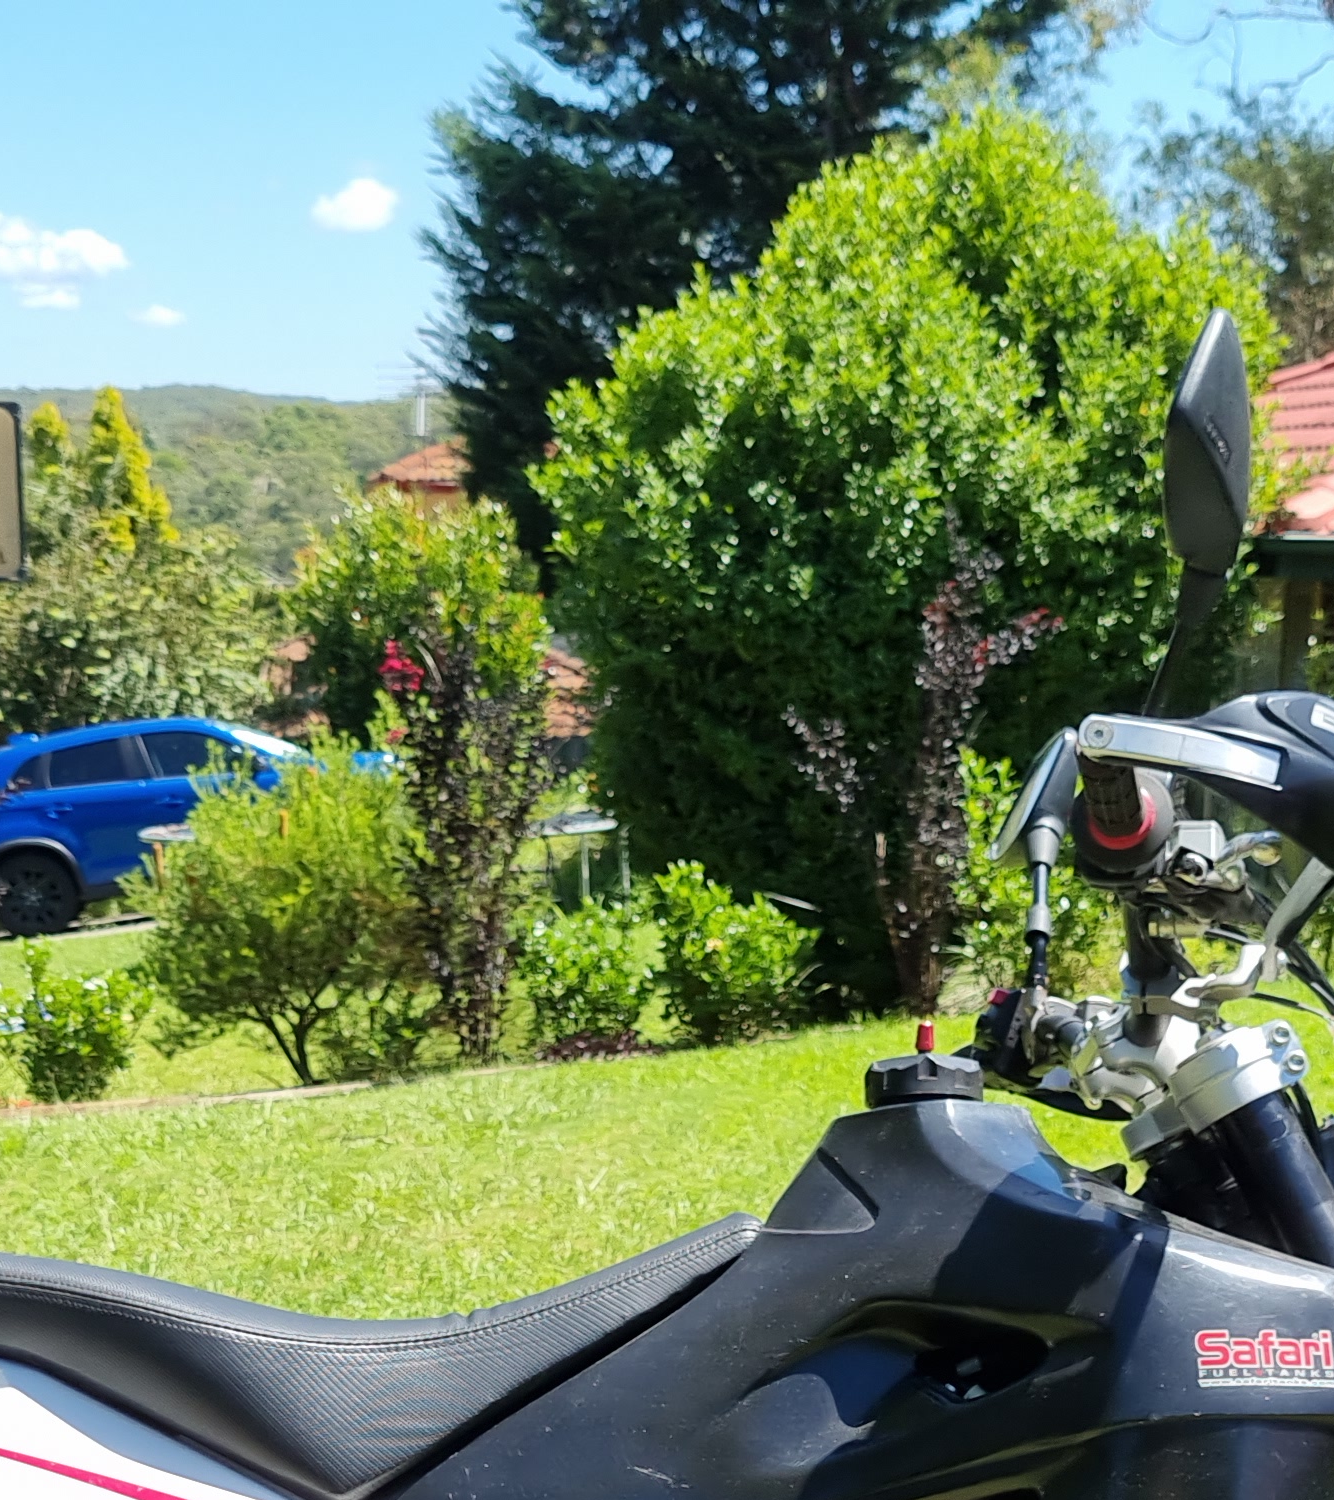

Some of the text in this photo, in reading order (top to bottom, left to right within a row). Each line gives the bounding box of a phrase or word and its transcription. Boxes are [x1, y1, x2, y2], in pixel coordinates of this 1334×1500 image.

[1195, 1330, 1334, 1368] Safari
[1199, 1368, 1334, 1378] FUEL TANKS
